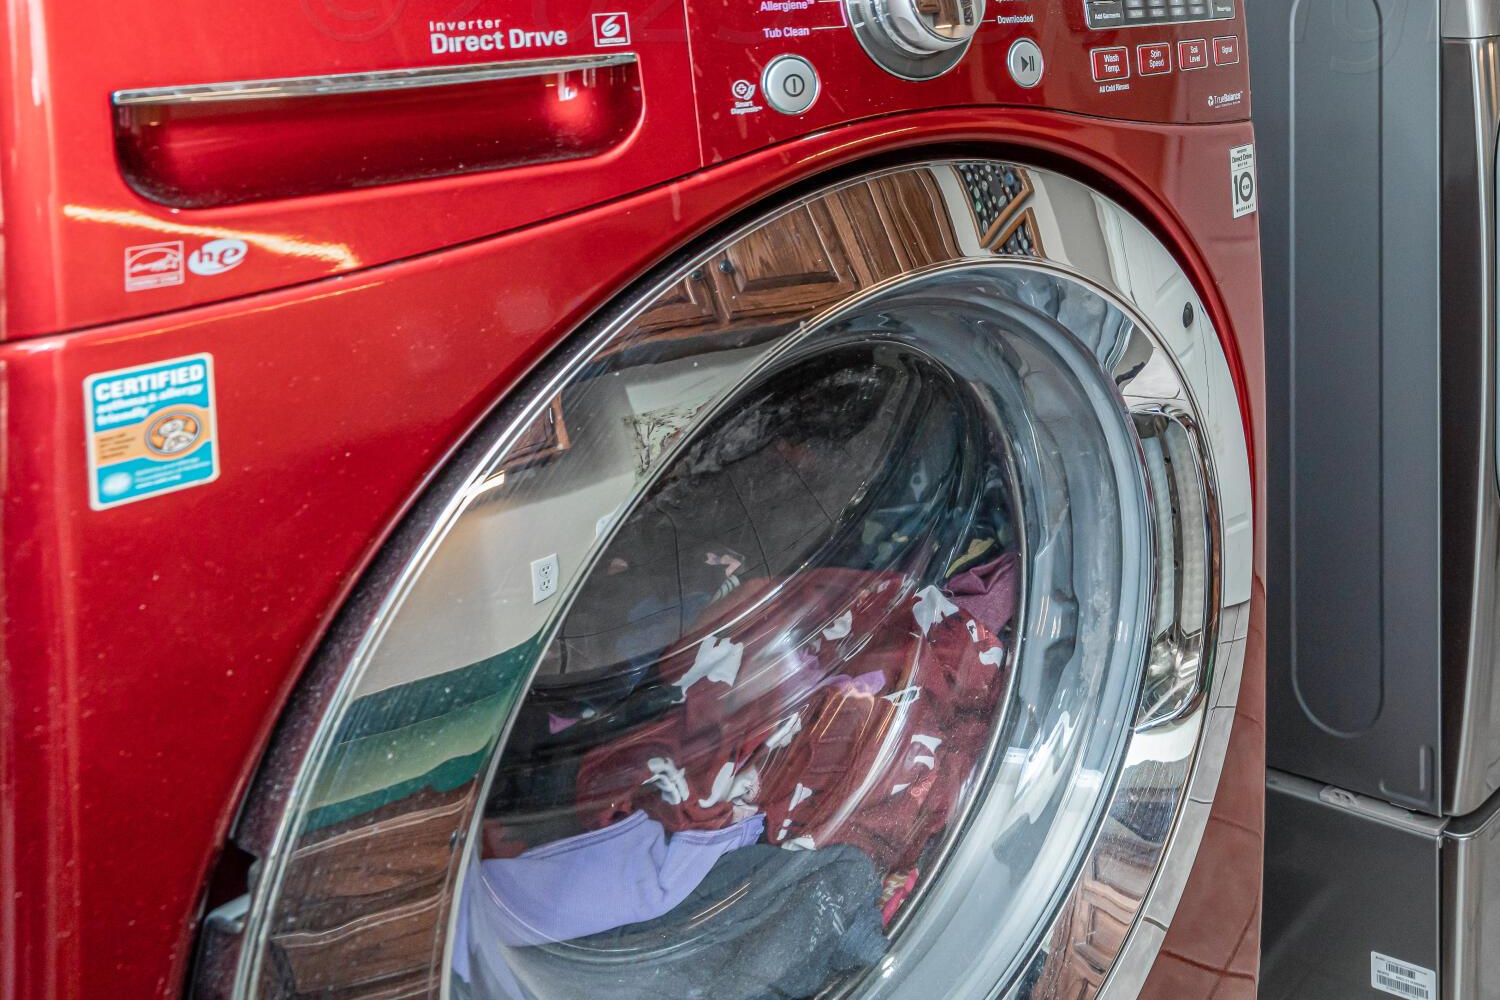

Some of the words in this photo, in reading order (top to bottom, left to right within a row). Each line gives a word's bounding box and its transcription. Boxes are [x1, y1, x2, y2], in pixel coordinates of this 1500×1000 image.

[997, 14, 1034, 25] Downloaded
[429, 18, 502, 32] Inverter
[762, 27, 782, 38] Tub
[783, 26, 811, 37] Clean
[430, 29, 505, 54] Direct
[508, 28, 568, 49] Drive
[1150, 49, 1162, 58] Spin
[1190, 45, 1199, 54] Soil
[1221, 45, 1233, 55] Signal
[1103, 54, 1120, 63] Wash
[1189, 55, 1201, 63] Level
[1149, 59, 1165, 68] Speed
[1103, 64, 1121, 73] Temp.
[1105, 84, 1116, 92] Cold
[1115, 83, 1130, 91] Rinses
[1234, 171, 1254, 205] 10
[94, 364, 205, 402] CERTIFIED
